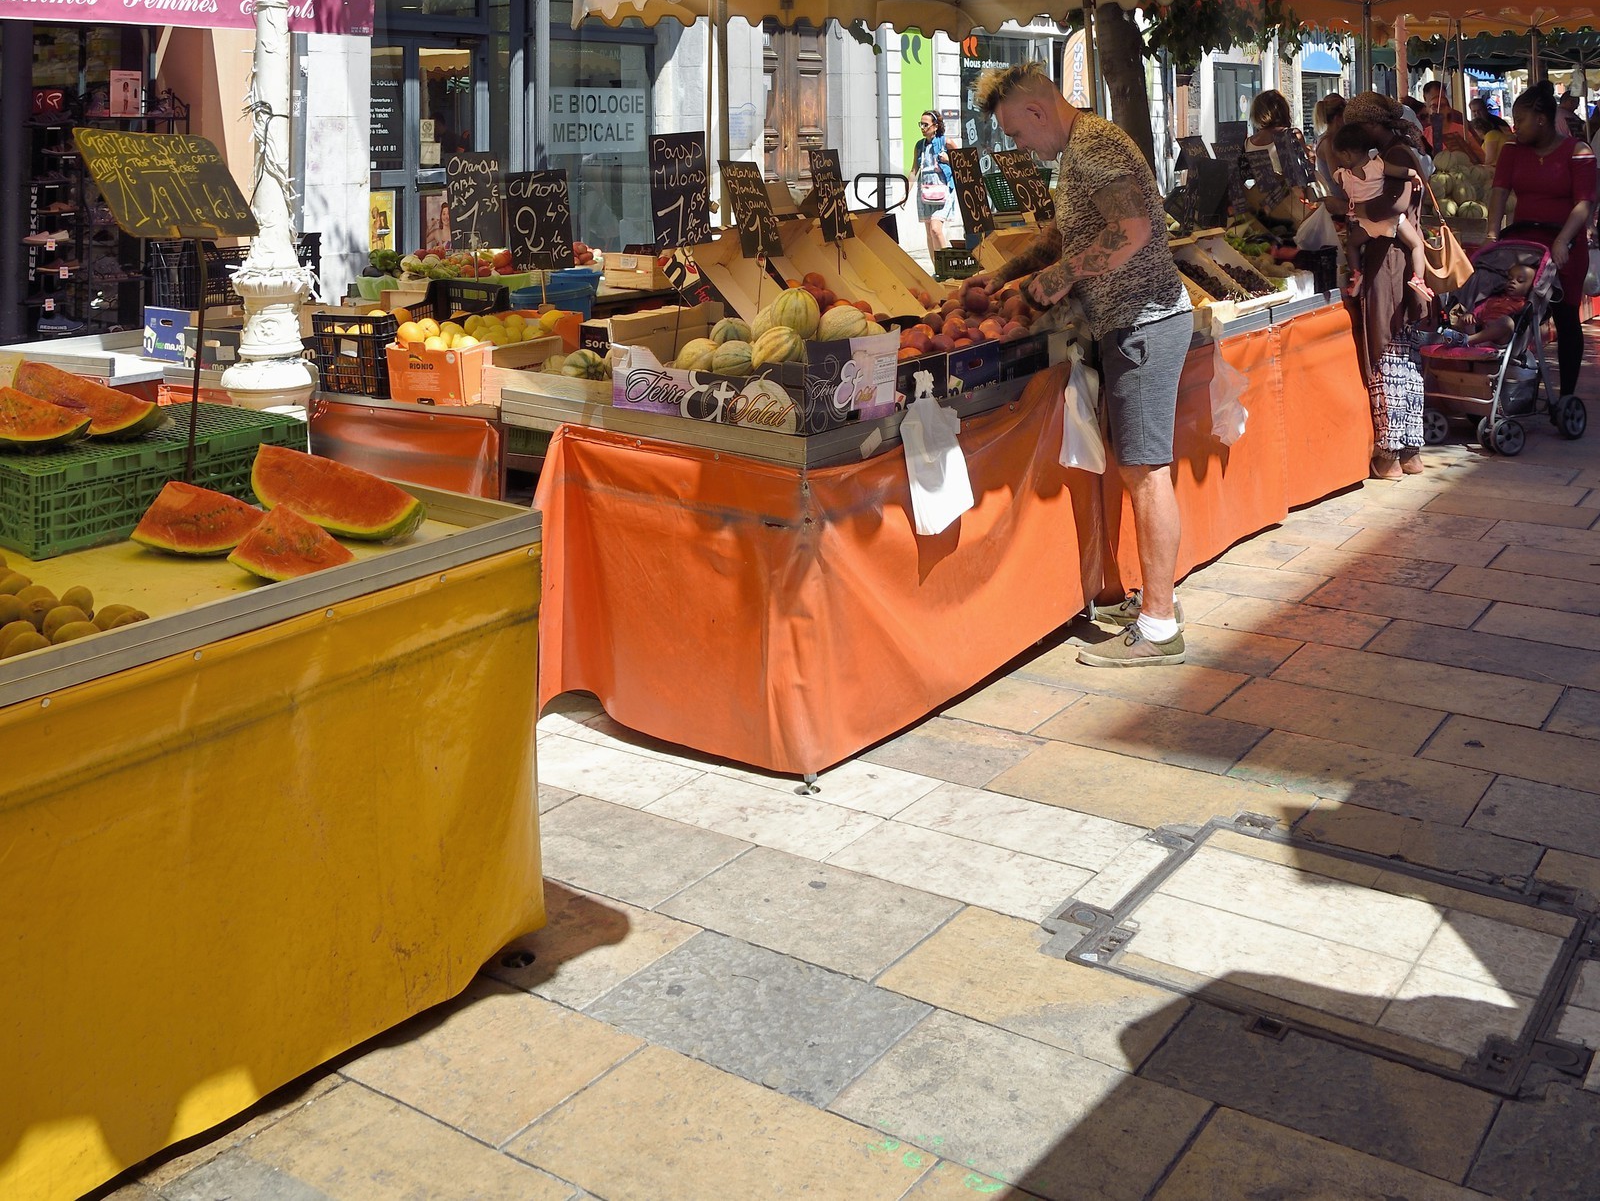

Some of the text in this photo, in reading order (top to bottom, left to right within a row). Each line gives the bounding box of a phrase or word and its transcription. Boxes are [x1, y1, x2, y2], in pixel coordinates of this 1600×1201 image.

[964, 57, 981, 69] Nous
[549, 94, 645, 114] E BIOLOGIE
[553, 122, 635, 143] MEDICALE
[28, 184, 39, 282] REDKINS
[626, 368, 686, 404] Terre
[726, 392, 797, 428] Soleil
